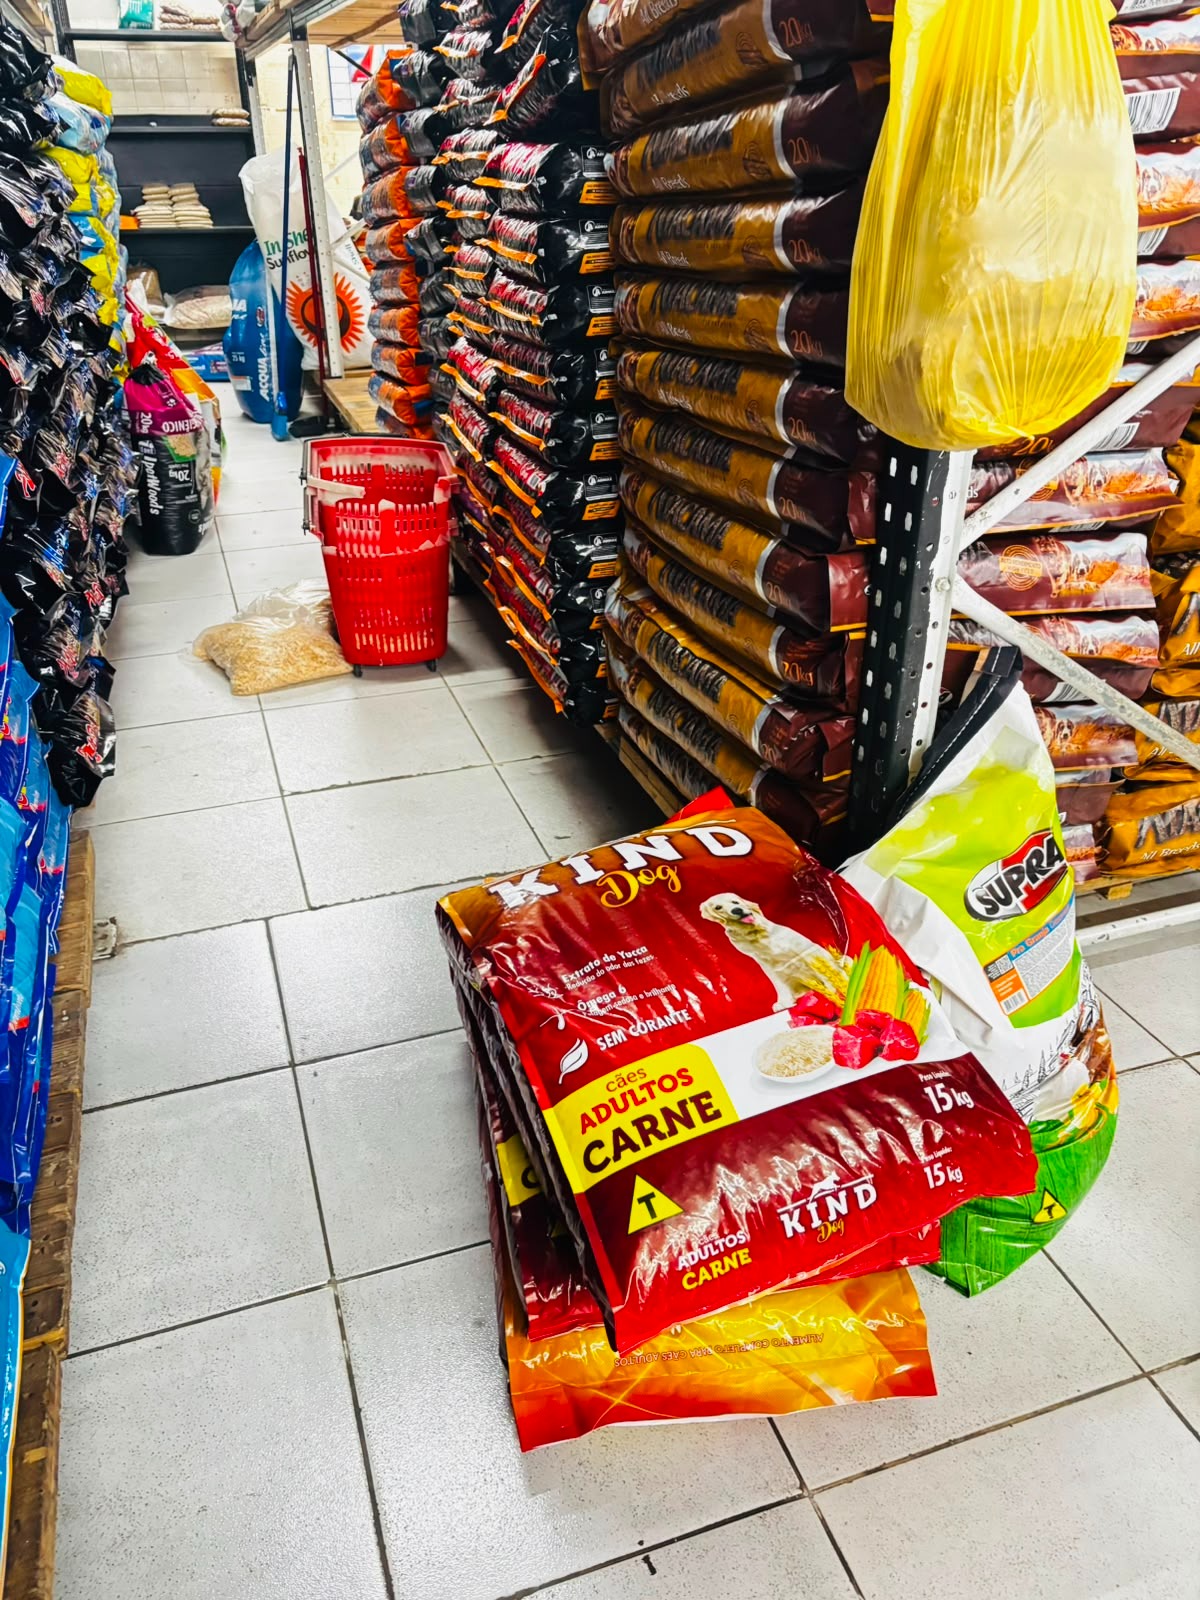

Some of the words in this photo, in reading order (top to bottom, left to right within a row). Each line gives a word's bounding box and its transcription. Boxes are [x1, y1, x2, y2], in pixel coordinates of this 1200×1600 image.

[263, 240, 283, 257] In
[168, 469, 190, 483] 20kg
[782, 661, 815, 687] 20kg
[489, 825, 754, 911] KIND
[974, 834, 1065, 916] SUPRA
[596, 863, 683, 909] Dog
[561, 958, 602, 984] Extrato
[602, 952, 618, 965] de
[616, 945, 649, 961] Yucca
[566, 974, 597, 991] Redução
[596, 967, 606, 978] do
[605, 961, 622, 973] odor
[622, 959, 635, 969] das
[634, 953, 655, 967] fezes
[577, 990, 617, 1012] Ômega
[618, 984, 628, 996] 6
[613, 994, 639, 1009] sedosa
[644, 982, 677, 999] brilhante
[595, 1029, 629, 1052] SEM
[629, 1008, 692, 1037] CORANTE
[605, 1067, 648, 1093] cães
[918, 1071, 933, 1084] Peso
[579, 1067, 695, 1135] ADULTOS
[582, 1090, 723, 1173] CARNE
[636, 1192, 658, 1220] T
[779, 1183, 878, 1239] KIND
[1043, 1202, 1056, 1220] T
[815, 1217, 846, 1244] Dog
[676, 1230, 747, 1271] ADULTOS
[681, 1248, 753, 1291] CARNE
[688, 1344, 715, 1359] PARA
[714, 1338, 771, 1355] COMPLETO
[770, 1332, 826, 1349] ALIMENTO
[612, 1351, 661, 1368] ADULTOS
[660, 1350, 688, 1364] CÃES
